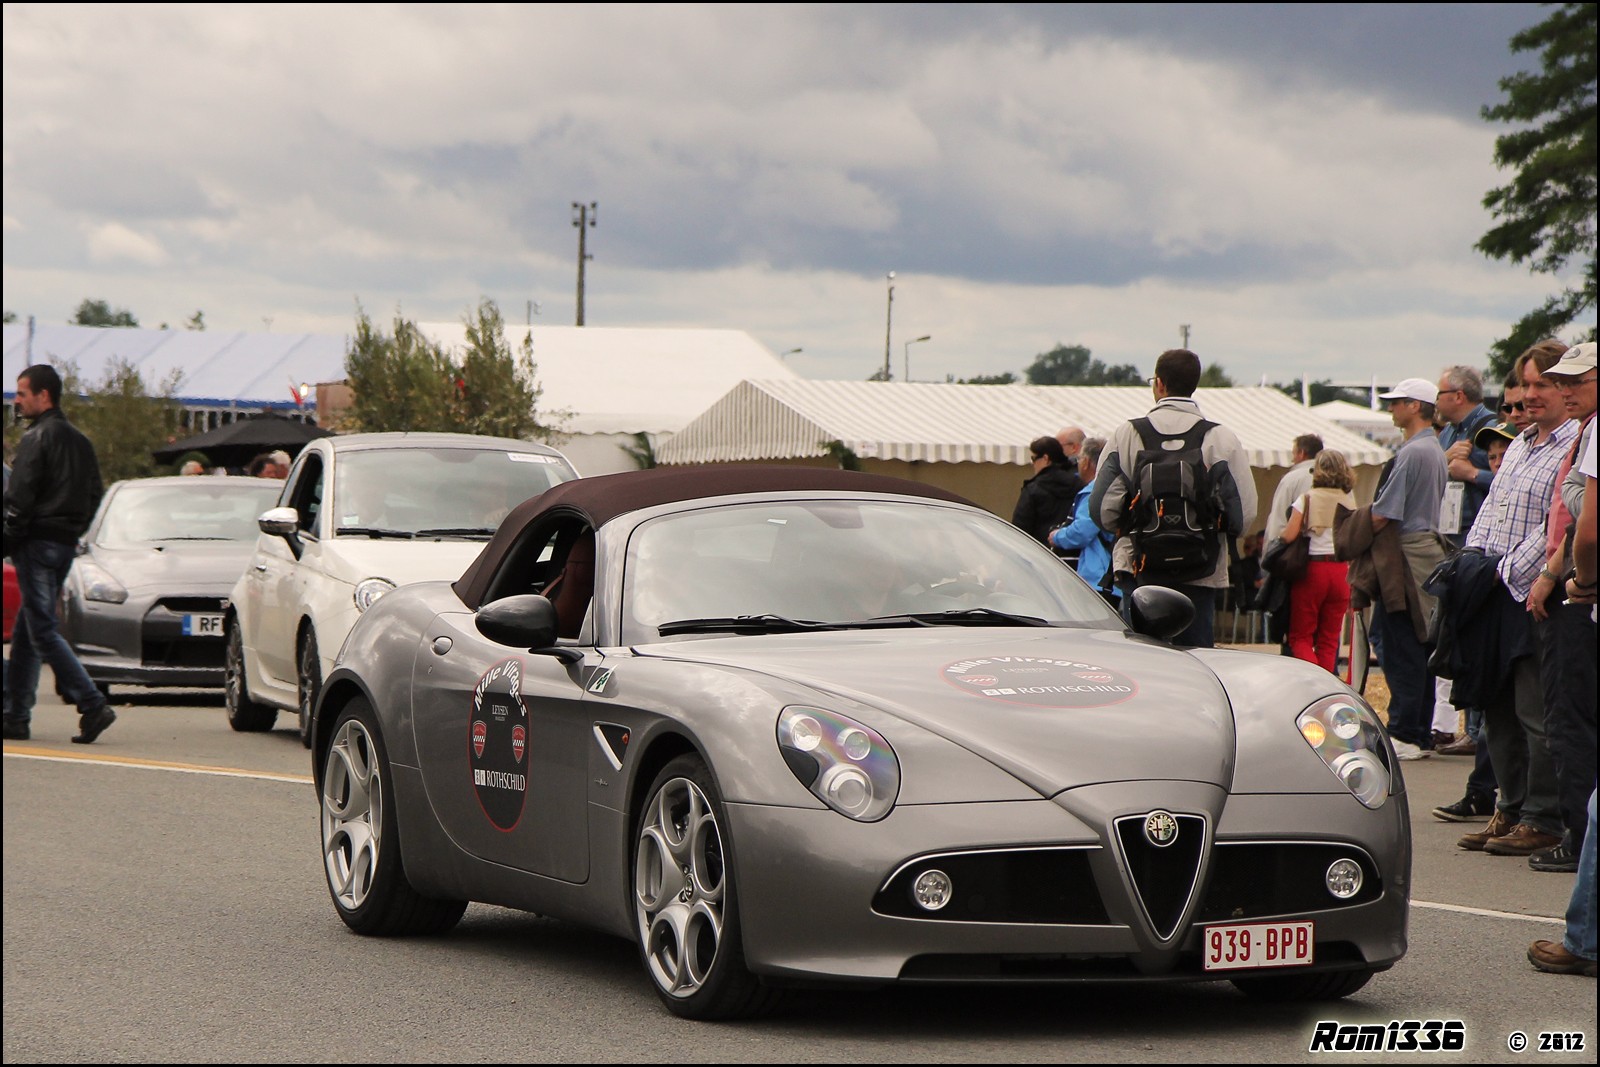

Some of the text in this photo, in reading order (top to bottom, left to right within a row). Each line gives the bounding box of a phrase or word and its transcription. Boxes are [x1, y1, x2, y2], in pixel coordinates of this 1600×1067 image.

[946, 656, 1102, 674] Mille Virages
[474, 660, 527, 717] Mille Virages
[1016, 685, 1132, 695] ROTHSCHILD
[486, 770, 526, 792] ROTHSCHILD
[1210, 926, 1308, 963] 939-BPB
